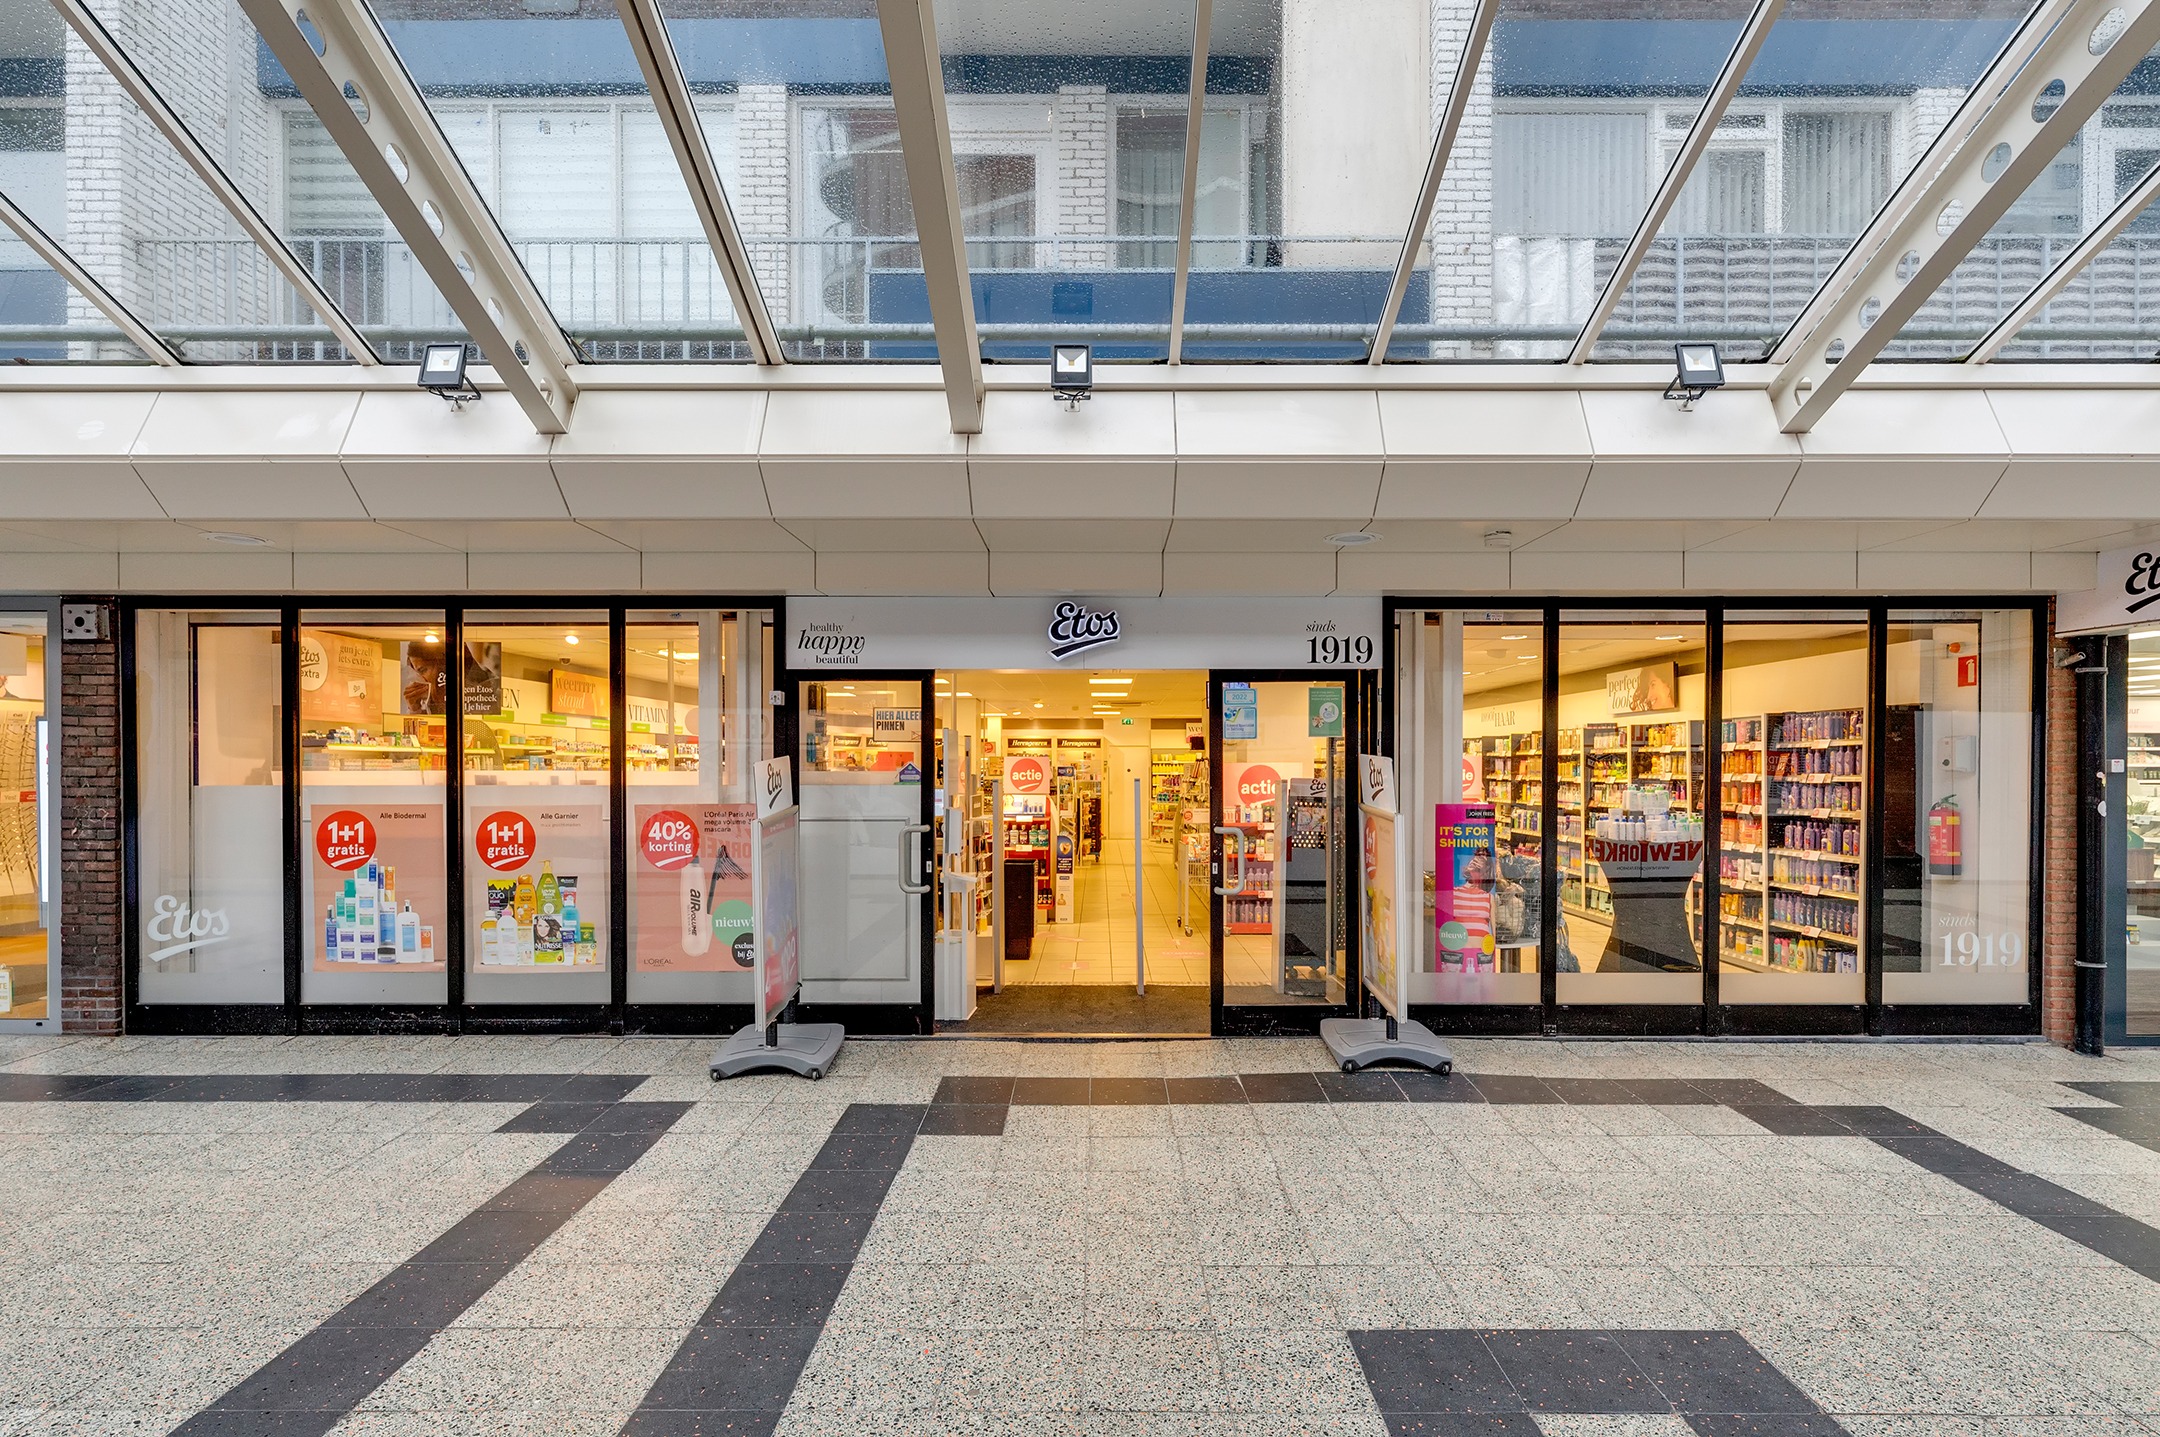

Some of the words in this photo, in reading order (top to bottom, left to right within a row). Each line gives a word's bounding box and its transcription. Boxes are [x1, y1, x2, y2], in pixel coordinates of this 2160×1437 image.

[2125, 552, 2160, 595] Et
[810, 623, 844, 634] healthy
[1048, 600, 1121, 643] Etos
[1305, 620, 1336, 633] sinds
[798, 629, 865, 655] happy
[1306, 635, 1374, 664] 1919
[815, 654, 858, 664] beautiful
[477, 685, 493, 694] Etos
[502, 687, 520, 709] EN
[558, 692, 586, 710] stand
[468, 703, 475, 712] je
[476, 703, 491, 711] hier
[876, 710, 894, 720] HIER
[895, 710, 922, 720] ALLEE
[876, 721, 905, 731] PINNEN
[766, 762, 783, 796] Etos
[1012, 769, 1042, 781] actie
[1368, 758, 1384, 789] Etos
[1309, 778, 1327, 791] Eto
[380, 812, 393, 820] Alle
[394, 811, 427, 820] Biodermal
[540, 812, 553, 820] Alle
[554, 812, 579, 820] Garnier
[328, 820, 365, 844] 1+1
[487, 820, 524, 845] 1+1
[648, 821, 691, 841] 40%
[1439, 826, 1463, 836] IT'S
[1465, 826, 1489, 836] FOR
[649, 841, 692, 854] korting
[1439, 838, 1489, 848] SHINING
[328, 844, 366, 859] gratis
[487, 844, 525, 859] gratis
[147, 894, 230, 942] Etos
[715, 916, 754, 928] nieuw!
[1938, 912, 1977, 927] sinds
[1441, 931, 1466, 940] nieuw!
[1939, 931, 2022, 967] 1919
